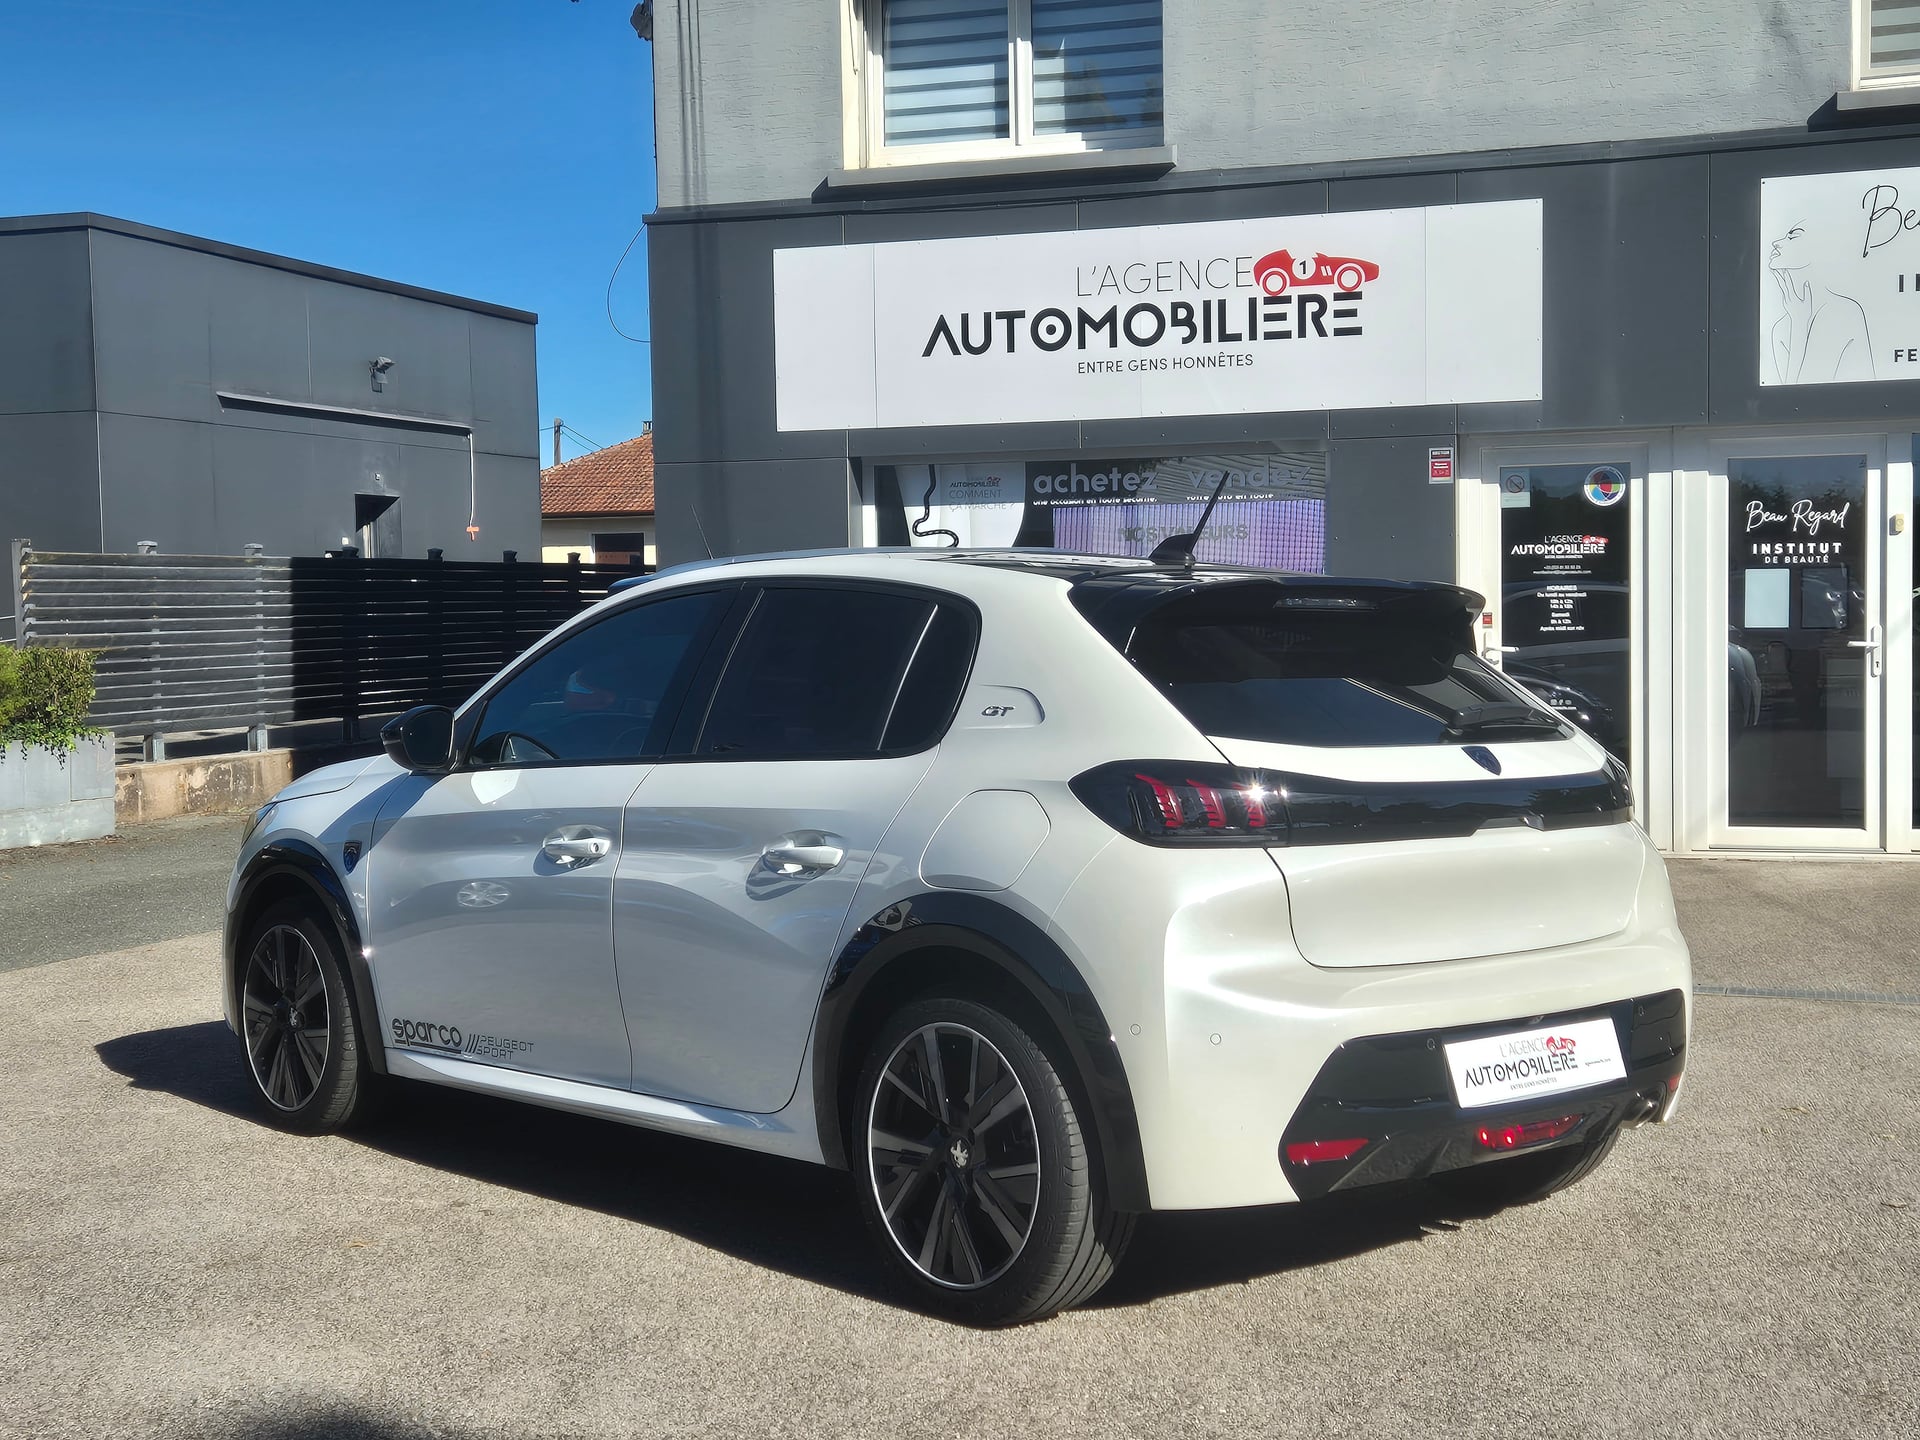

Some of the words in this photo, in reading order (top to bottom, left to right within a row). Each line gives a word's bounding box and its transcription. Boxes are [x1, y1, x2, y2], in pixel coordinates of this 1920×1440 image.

[1862, 184, 1920, 258] Be
[1077, 256, 1253, 297] L'AGENCE
[1299, 260, 1307, 275] 1
[1899, 273, 1920, 293] I
[921, 291, 1363, 358] AUTOMOBILIERE
[1077, 360, 1123, 374] ENTRE
[1127, 357, 1168, 371] GENS
[1172, 352, 1254, 370] HONNÊTES
[1033, 463, 1158, 494] achetez
[1187, 456, 1315, 489] vendez
[1746, 500, 1788, 532] Beau
[1791, 499, 1850, 535] Regard
[1544, 535, 1583, 543] L'AGENCE
[1752, 542, 1842, 554] INSTITUT
[1764, 556, 1779, 564] DE
[1784, 554, 1829, 564] BEAUTÉ
[981, 705, 1014, 717] GT
[392, 1018, 462, 1047] sparco
[476, 1046, 514, 1060] SPORT
[480, 1034, 534, 1053] PEUGEOT
[1466, 1051, 1579, 1089] AUTOMOBILIERE
